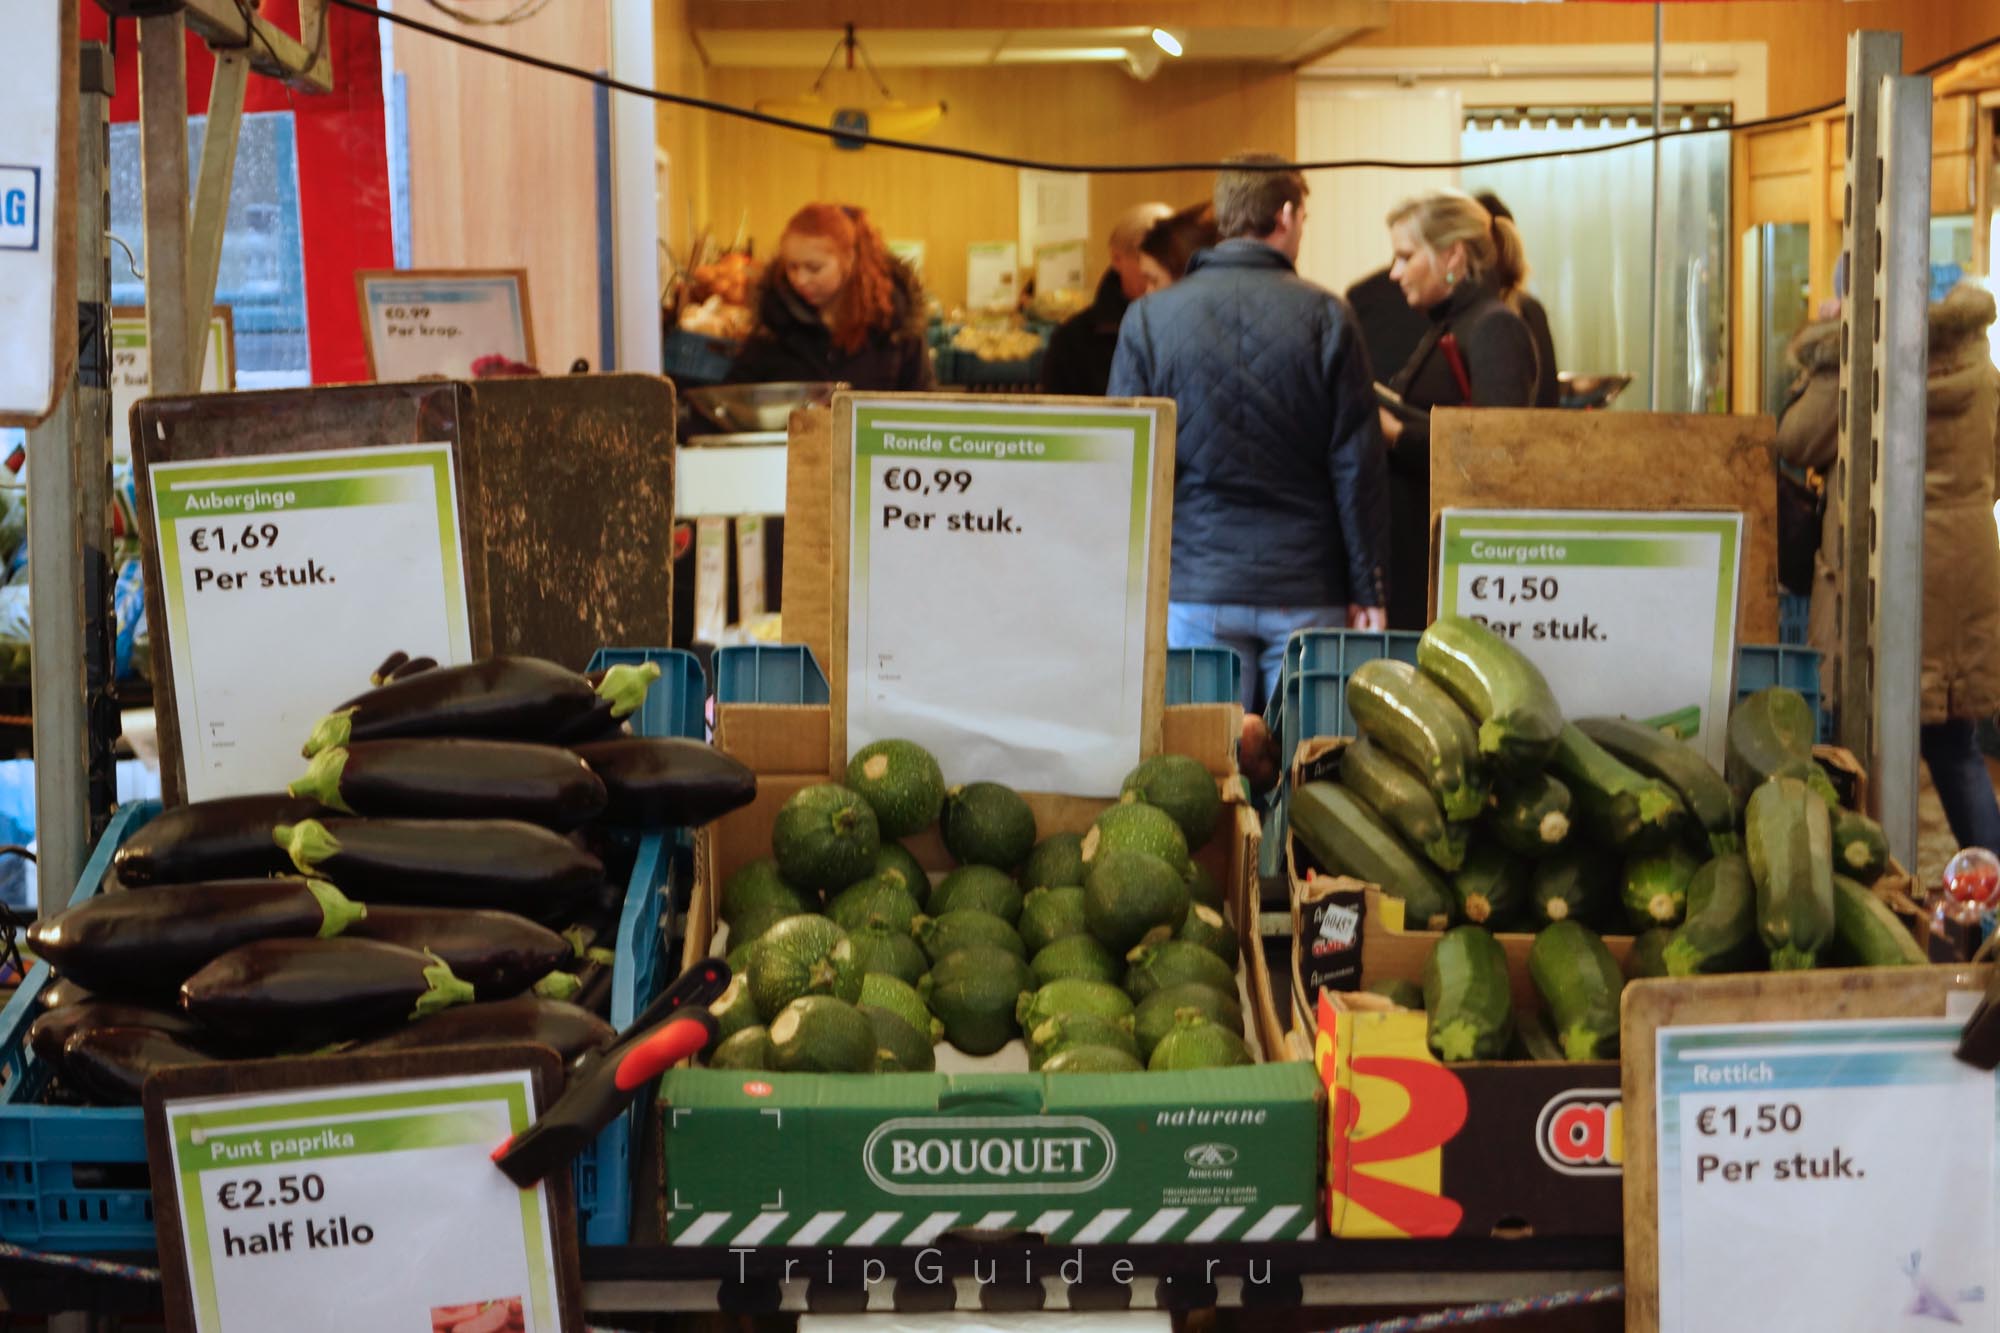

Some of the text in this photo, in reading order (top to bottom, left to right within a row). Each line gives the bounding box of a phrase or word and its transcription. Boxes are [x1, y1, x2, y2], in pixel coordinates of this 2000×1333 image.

[387, 324, 416, 337] Per
[882, 432, 1046, 458] Ronde Courgette
[883, 466, 973, 496] €0,99
[184, 489, 296, 512] Auberginge
[883, 504, 1023, 534] Per stuk.
[189, 523, 279, 555] €1,69
[1470, 540, 1568, 562] Courgette
[194, 558, 336, 593] Per stuk.
[1470, 574, 1559, 606] €1,50
[1531, 613, 1609, 641] stuk.
[1693, 1060, 1775, 1085] Rettich
[1156, 1106, 1267, 1126] naturane
[1696, 1102, 1803, 1139] €1,50
[210, 1130, 355, 1160] Punt paprika
[891, 1137, 1092, 1177] BOUQUET
[1696, 1146, 1866, 1184] Per stuk.
[217, 1173, 326, 1212] €2.50
[222, 1214, 375, 1258] half kilo
